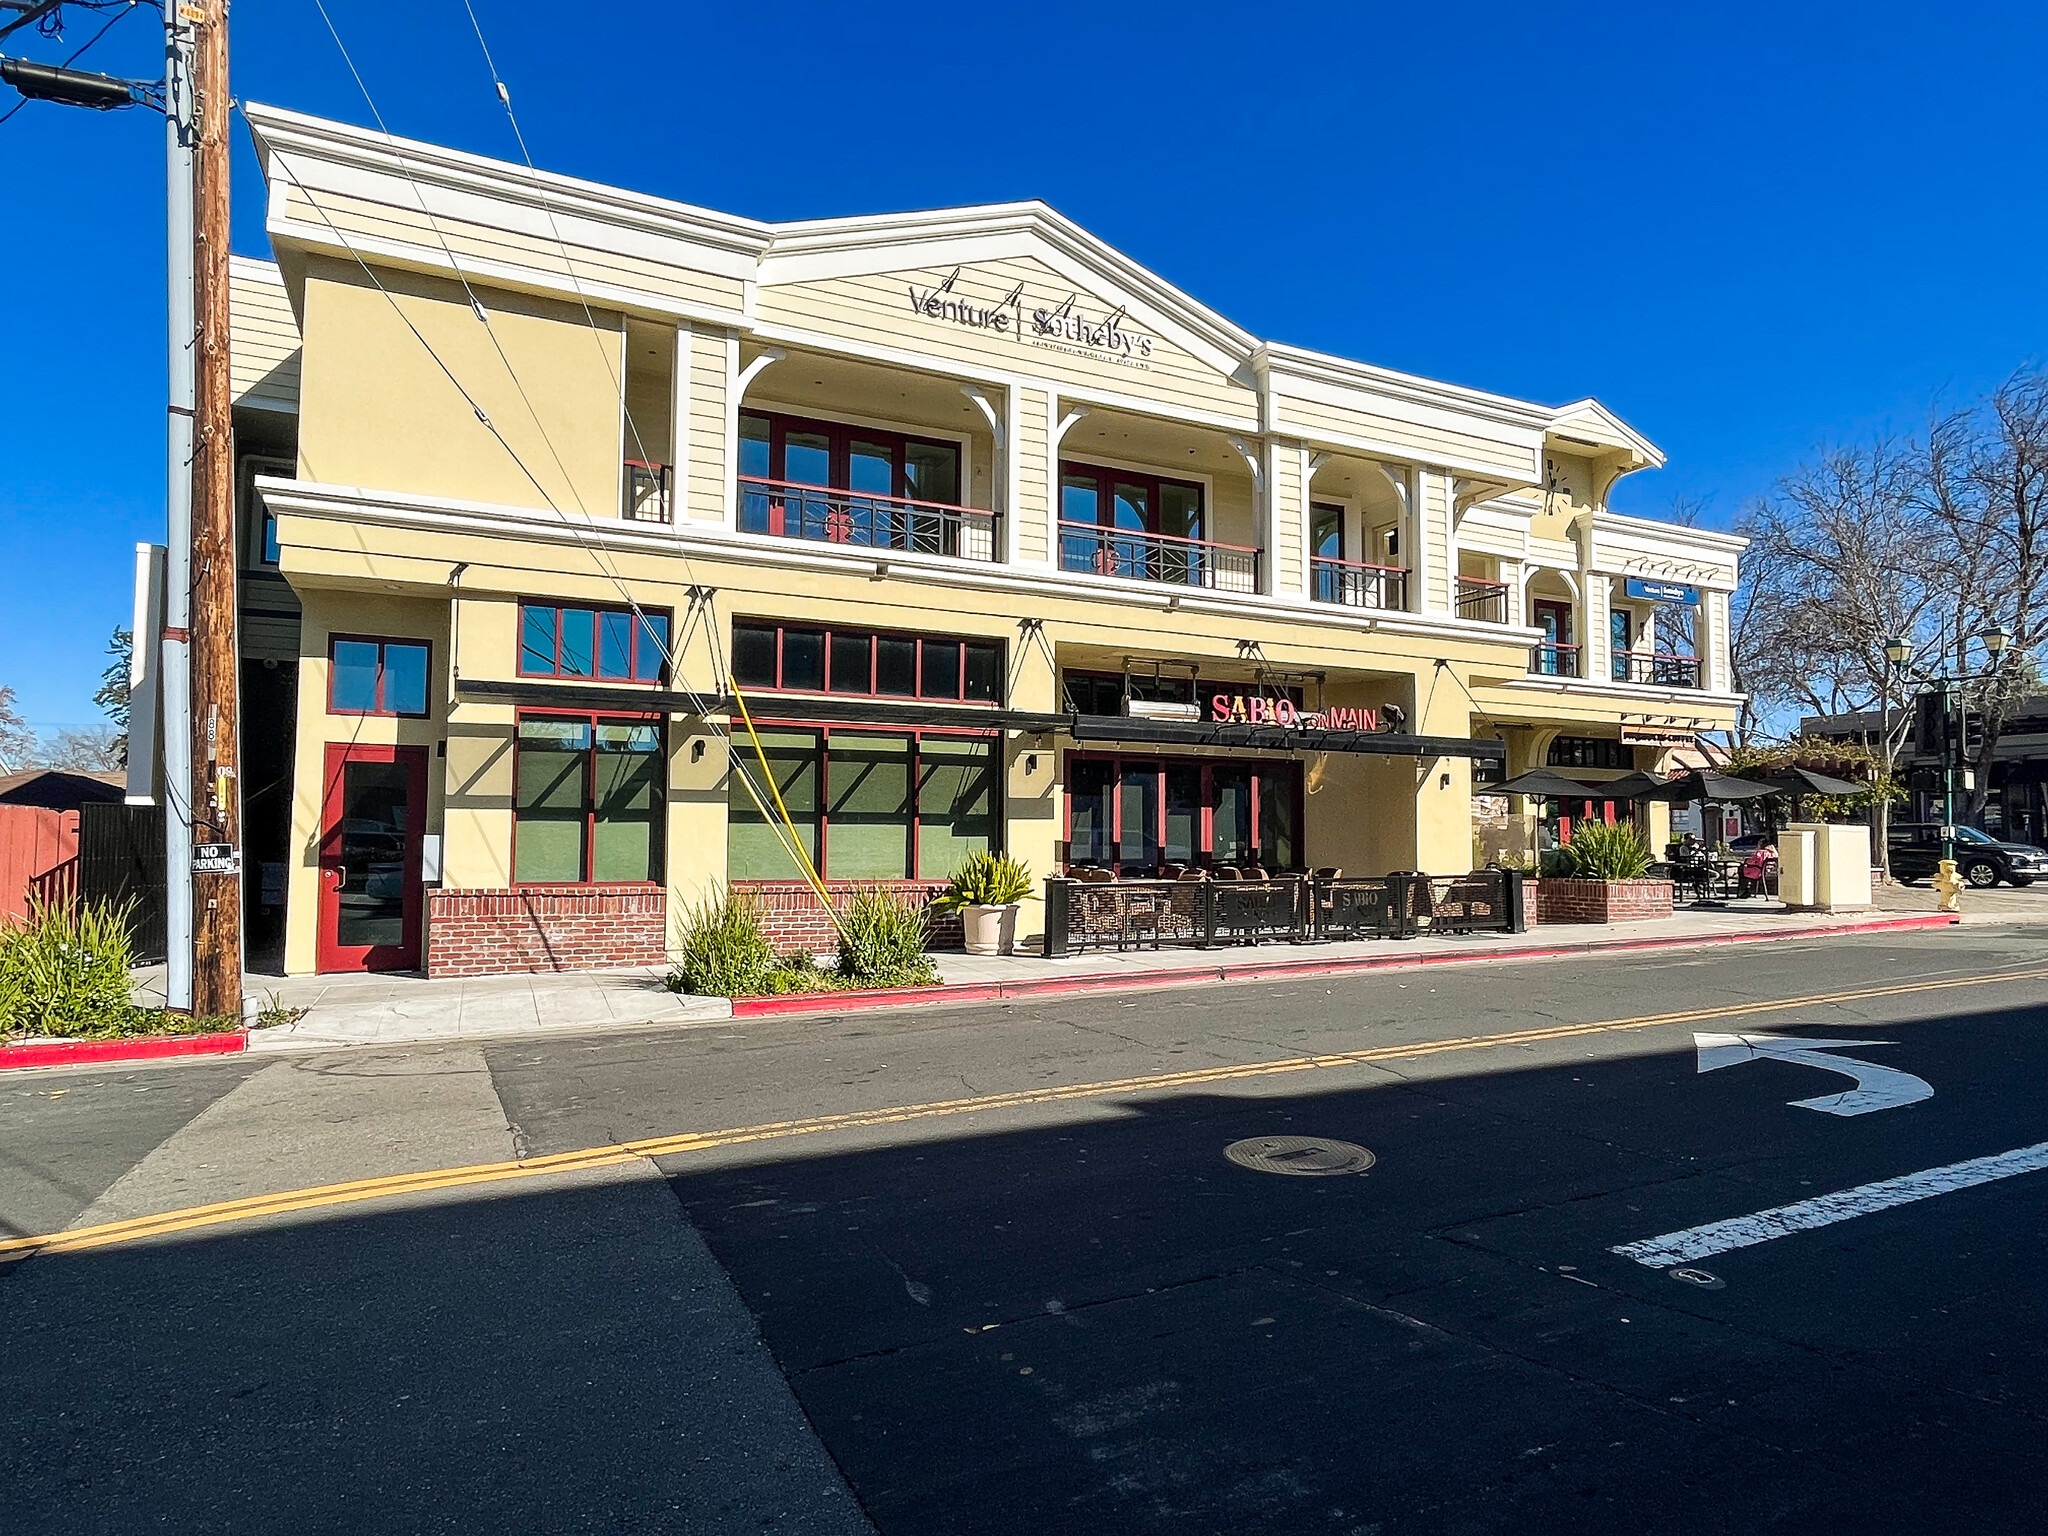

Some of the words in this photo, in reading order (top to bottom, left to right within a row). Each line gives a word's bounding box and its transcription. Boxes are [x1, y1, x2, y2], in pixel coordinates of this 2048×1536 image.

[908, 285, 1010, 333] Venture
[1032, 307, 1152, 358] Sotheby's
[1330, 706, 1376, 731] MAIN
[200, 846, 219, 858] NO
[192, 857, 233, 870] PARKING
